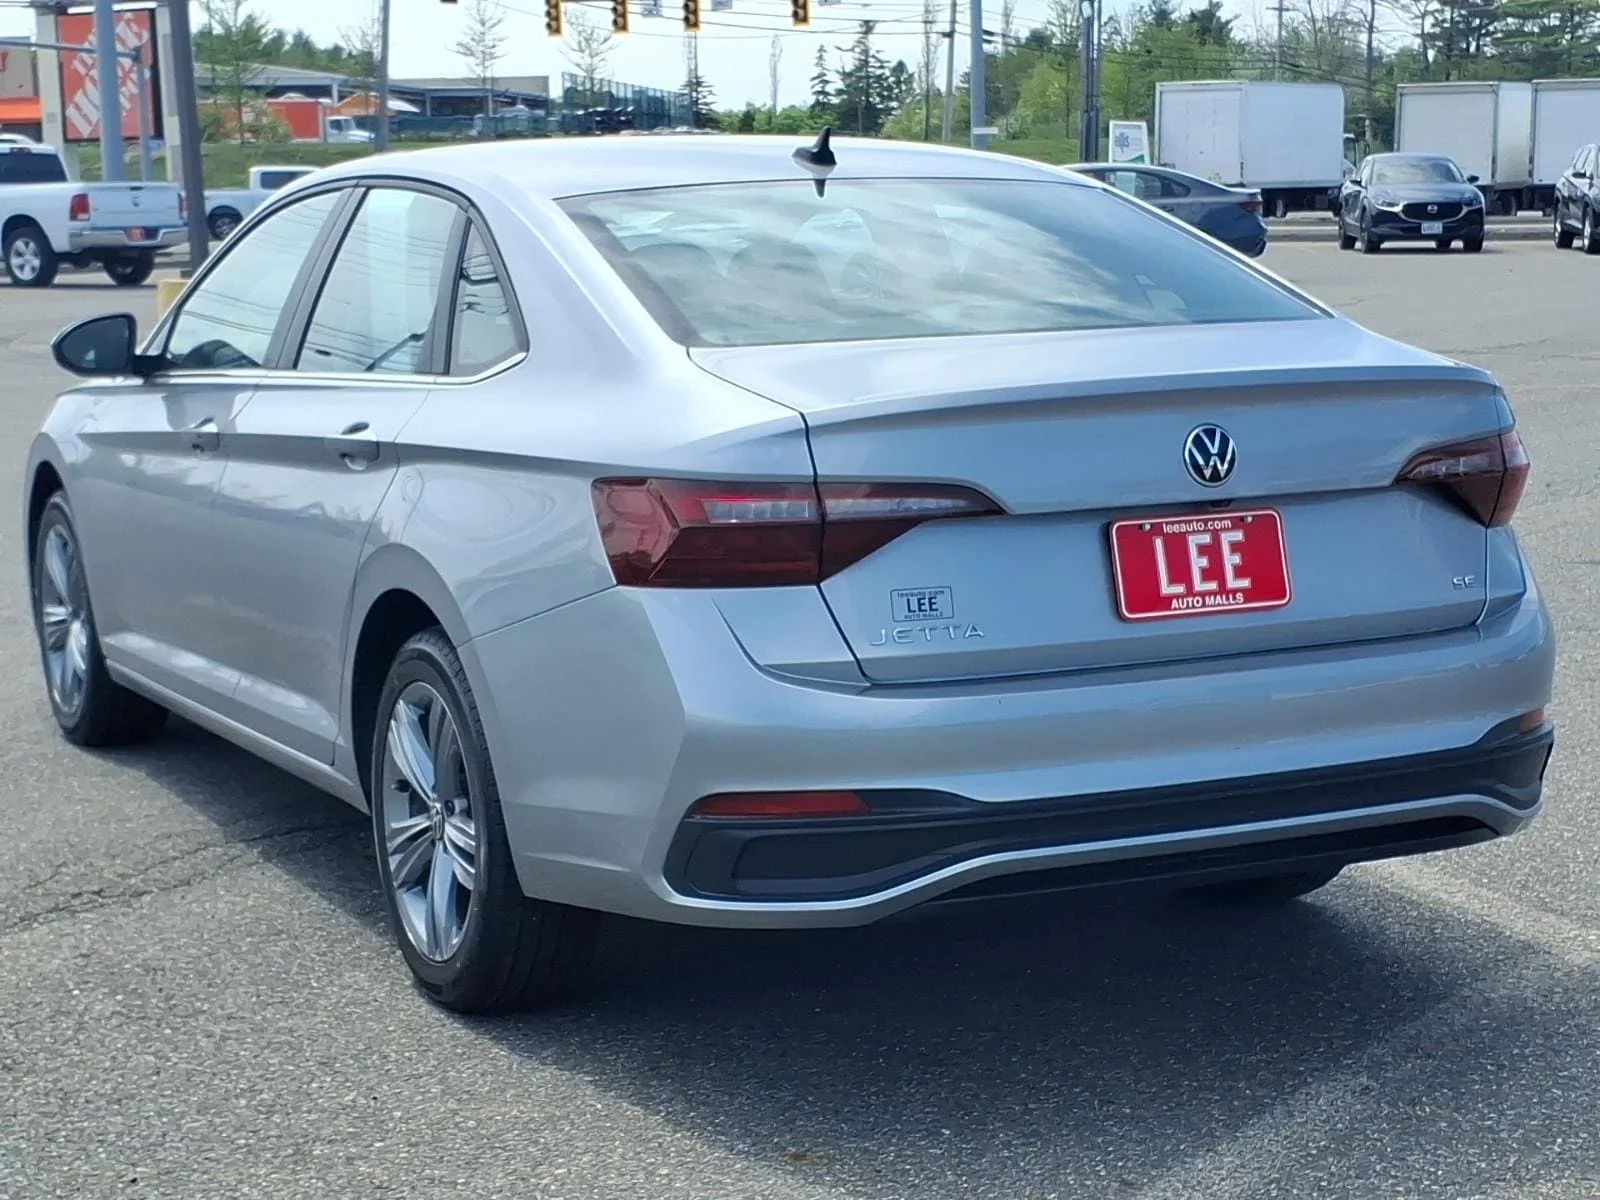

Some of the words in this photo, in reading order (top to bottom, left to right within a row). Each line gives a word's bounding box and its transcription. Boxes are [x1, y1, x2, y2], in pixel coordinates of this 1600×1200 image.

[1162, 519, 1232, 534] leeauto.com
[1153, 529, 1251, 597] LEE
[906, 596, 939, 613] LEE
[1170, 596, 1203, 610] AUTO
[1205, 592, 1244, 607] MALLS
[870, 623, 985, 646] JETTA
